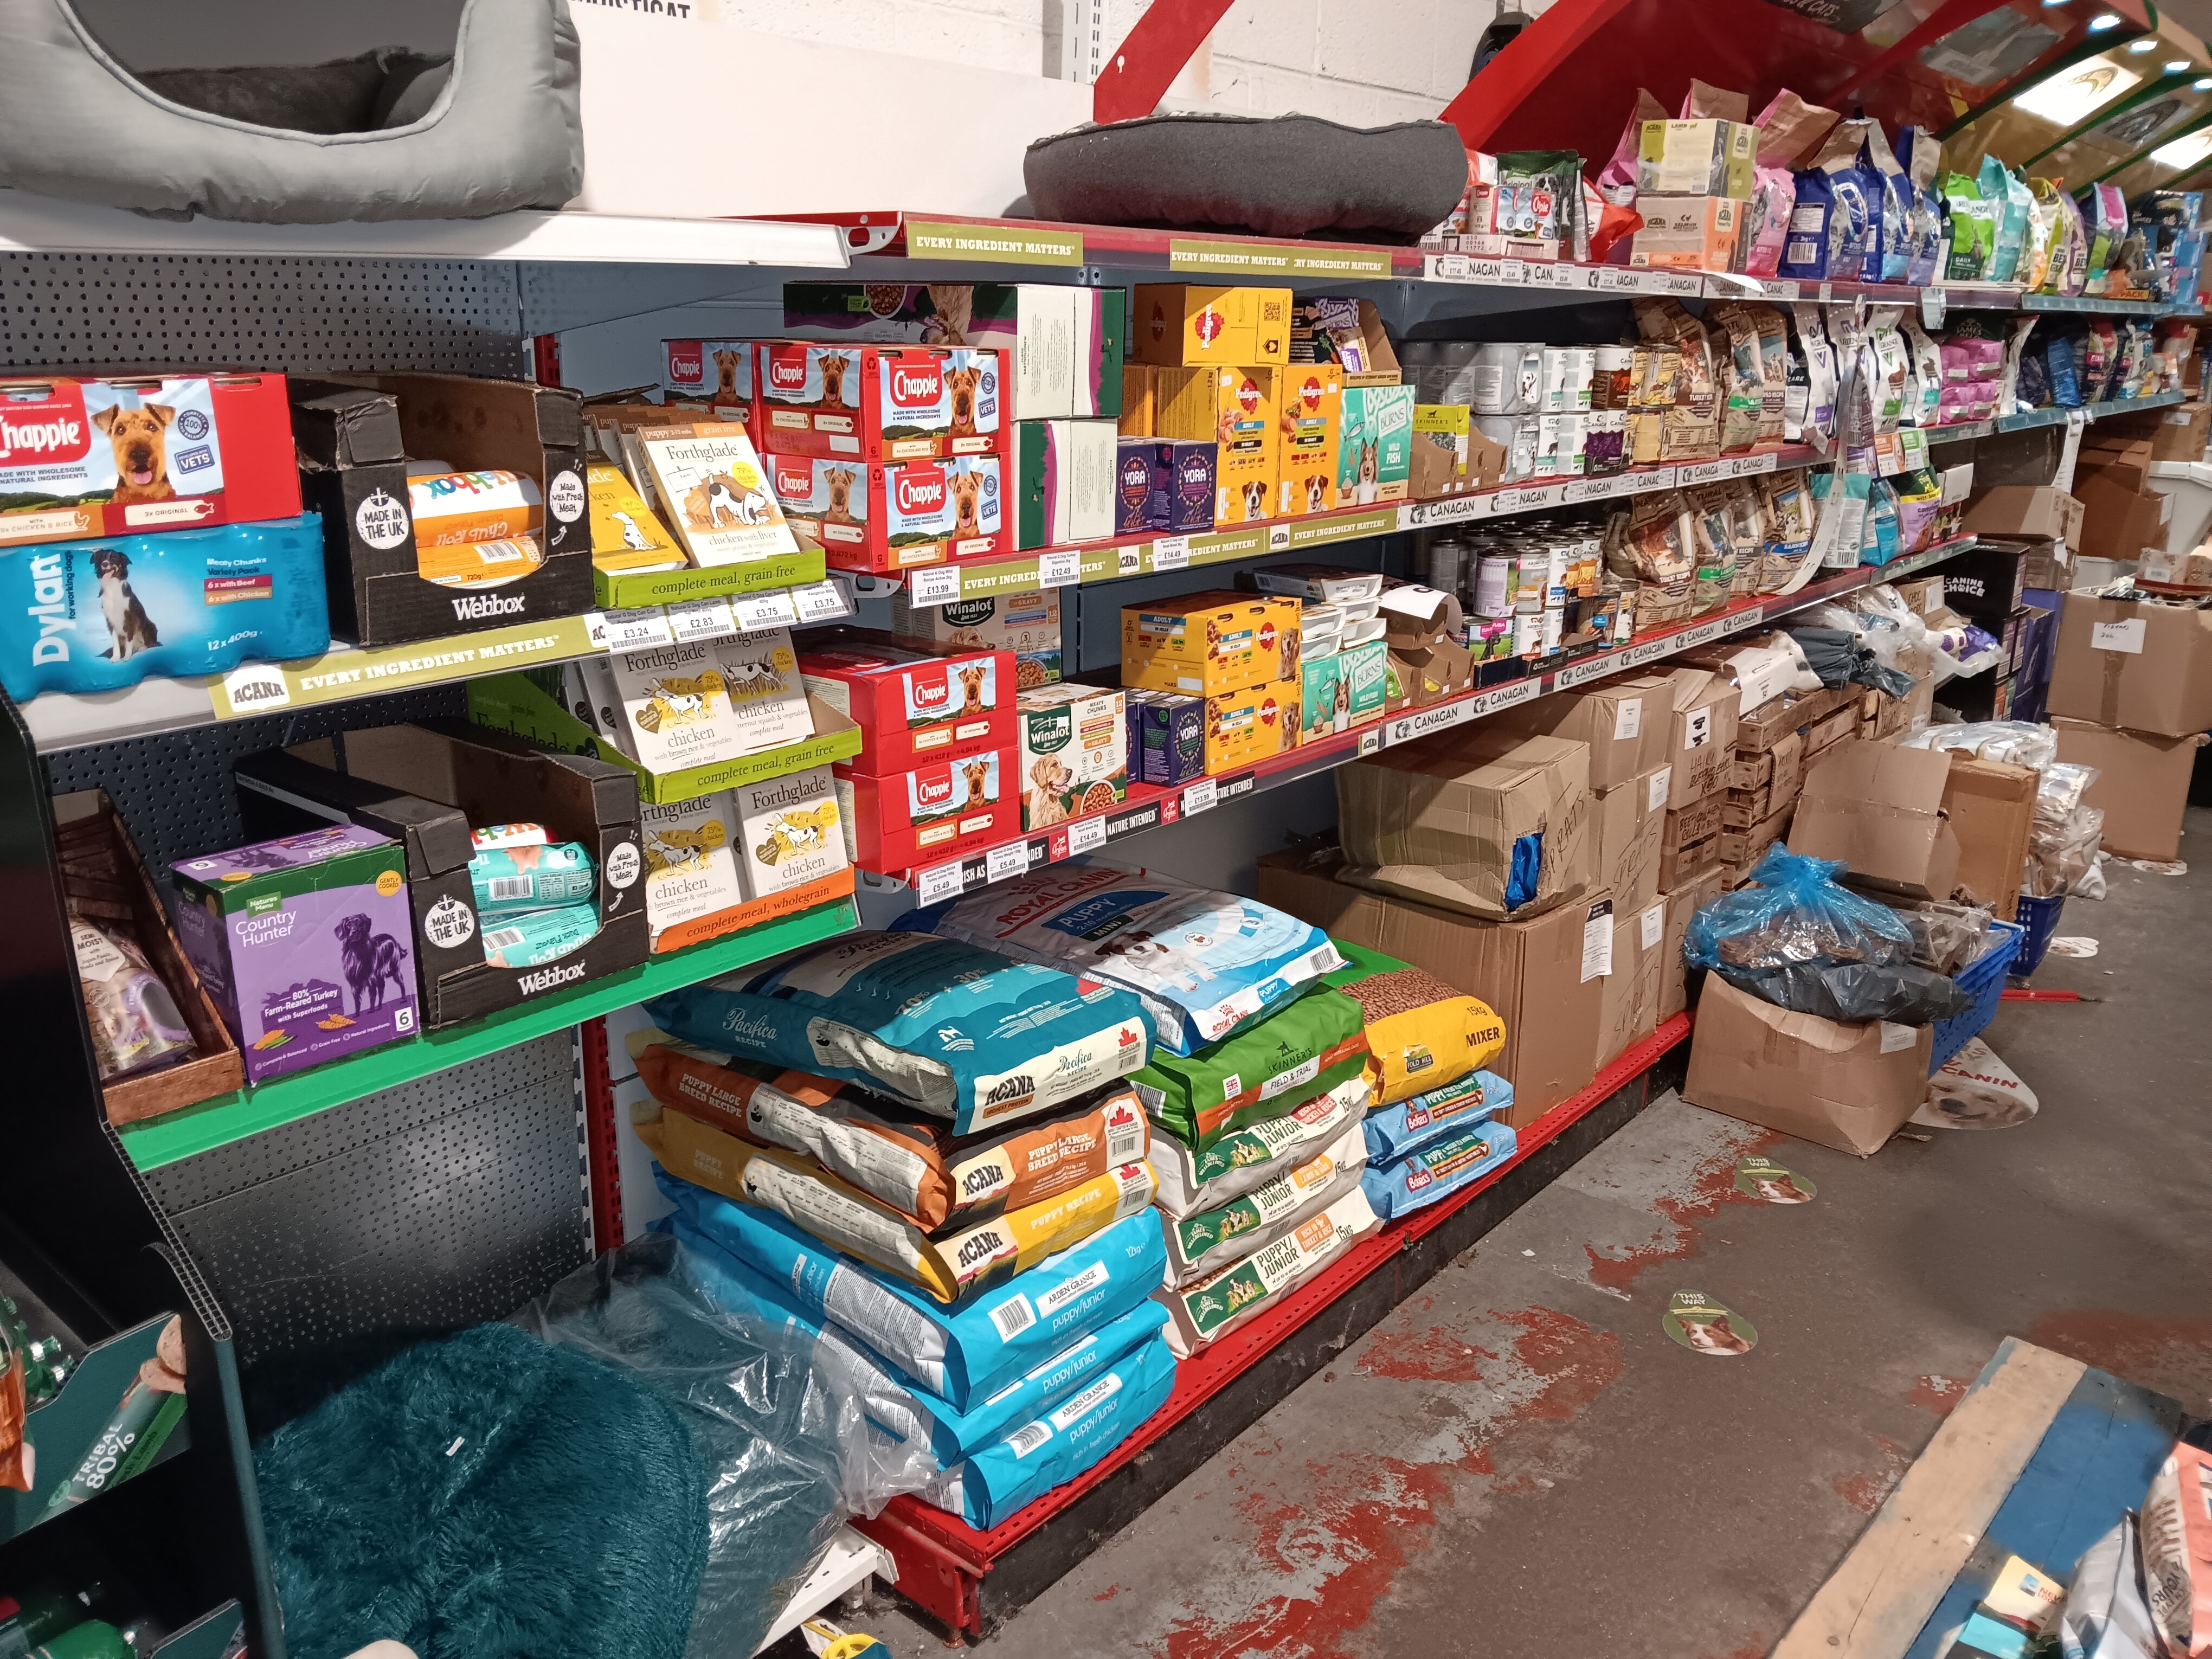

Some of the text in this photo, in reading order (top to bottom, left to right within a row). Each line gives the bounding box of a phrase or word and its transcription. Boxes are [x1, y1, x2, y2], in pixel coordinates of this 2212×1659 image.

[916, 236, 1072, 256] EVERY INGREDIENT MATTERS
[1172, 252, 1286, 267] EVERY INGREDIENT MATTERS
[1307, 259, 1381, 271] INGREDIENT MATTERS
[1468, 263, 1501, 276] NAGAN
[1201, 304, 1212, 349] Pedigree
[773, 362, 803, 383] Chappie
[894, 371, 938, 401] Chappie
[1235, 388, 1263, 400] Pedigree
[1380, 408, 1404, 429] BURNS
[181, 455, 210, 468] VETS
[666, 443, 738, 462] Forthglade
[1386, 452, 1401, 464] FISH
[1, 473, 88, 484] NATURAL INGREDIENTS
[778, 471, 810, 493] Chappie
[1184, 469, 1206, 483] YORA
[364, 509, 402, 522] MADE IN
[1430, 501, 1475, 516] CANAGAN
[365, 522, 404, 538] THE UK
[709, 534, 743, 545] chicken
[760, 531, 777, 539] liver
[1271, 534, 1288, 544] ACANA
[1295, 519, 1384, 540] EVERY INGREDIENT MATTERS
[65, 551, 74, 571] dogs
[207, 557, 267, 568] Meaty Chunks
[652, 566, 795, 595] complete meal, grain free
[964, 571, 1040, 589] EVERY INGREDI
[1052, 567, 1071, 576] £12.49
[62, 573, 75, 604] working
[927, 584, 949, 594] £13.99
[1946, 577, 1984, 587] CANINE
[28, 554, 76, 666] Dylan
[452, 595, 525, 621] Webbox
[756, 607, 778, 616] £3.75
[815, 599, 834, 608] £3.75
[946, 598, 993, 616] Winalot
[691, 617, 713, 628] £2.83
[1734, 612, 1758, 627] CANAGAN
[208, 640, 219, 651] 12
[228, 631, 258, 644] 400g
[624, 627, 648, 638] £3.24
[1255, 630, 1278, 641] Pedigree
[624, 644, 705, 672] Forthglade
[1634, 642, 1664, 659] CANAGAN
[300, 637, 555, 690] EVERY INGREDIENT MATTERS
[1358, 663, 1381, 684] BURNS
[234, 683, 285, 702] ACANA
[1491, 685, 1528, 705] CANAGAN
[738, 700, 785, 720] chicken
[1415, 708, 1457, 729] CANAGAN
[668, 729, 715, 748] chicken
[1031, 728, 1070, 744] Winalot
[697, 744, 834, 786] complete meal, grain free
[751, 777, 826, 809] Forthglade
[1194, 794, 1210, 803] £13.99
[1108, 809, 1157, 835] NATURE INTENDED
[1081, 833, 1097, 843] £14.49
[1000, 859, 1015, 870] £5.49
[933, 882, 949, 892] £5.49
[250, 896, 278, 907] Natures
[995, 890, 1063, 925] ROYAL
[687, 887, 829, 937] complete meal, wholegrain
[1063, 897, 1117, 928] PUPPY
[236, 910, 297, 935] Country
[1093, 921, 1121, 937] MINI
[77, 937, 103, 950] MOIST
[242, 924, 293, 947] Hunter
[518, 962, 585, 995] Webbox
[265, 989, 338, 1017] Farm-Reared Turkey
[293, 989, 309, 1000] 80%
[278, 1003, 328, 1022] with Superfoods
[722, 1008, 777, 1039] Pacifica
[735, 1037, 767, 1049] RECIPE
[1466, 1027, 1499, 1047] MIXER
[1058, 1050, 1092, 1071] Pacifica
[1269, 1049, 1311, 1075] SKINNER'S
[1271, 1075, 1289, 1090] FIELD
[1295, 1065, 1311, 1079] TRIAL
[1941, 1067, 2018, 1089] CANIN
[682, 1073, 741, 1107] PUPPY LARGE
[987, 1076, 1034, 1103] ACANA
[679, 1082, 742, 1118] BREED RECIPE
[986, 1098, 1029, 1117] HIGHEST PROTEIN
[963, 1165, 1004, 1195] ACANA
[1031, 1189, 1101, 1229] PUPPY RECIPE
[957, 1231, 1002, 1268] ACANA
[1257, 1237, 1291, 1265] PUPPY/
[1264, 1248, 1299, 1278] JUNIOR
[1049, 1270, 1097, 1304] ARDEN GRANGE
[1052, 1289, 1106, 1333] puppy/junior
[1069, 1399, 1118, 1444] puppy/junior
[73, 1423, 123, 1483] TRIBAL
[86, 1433, 135, 1489] 80%
